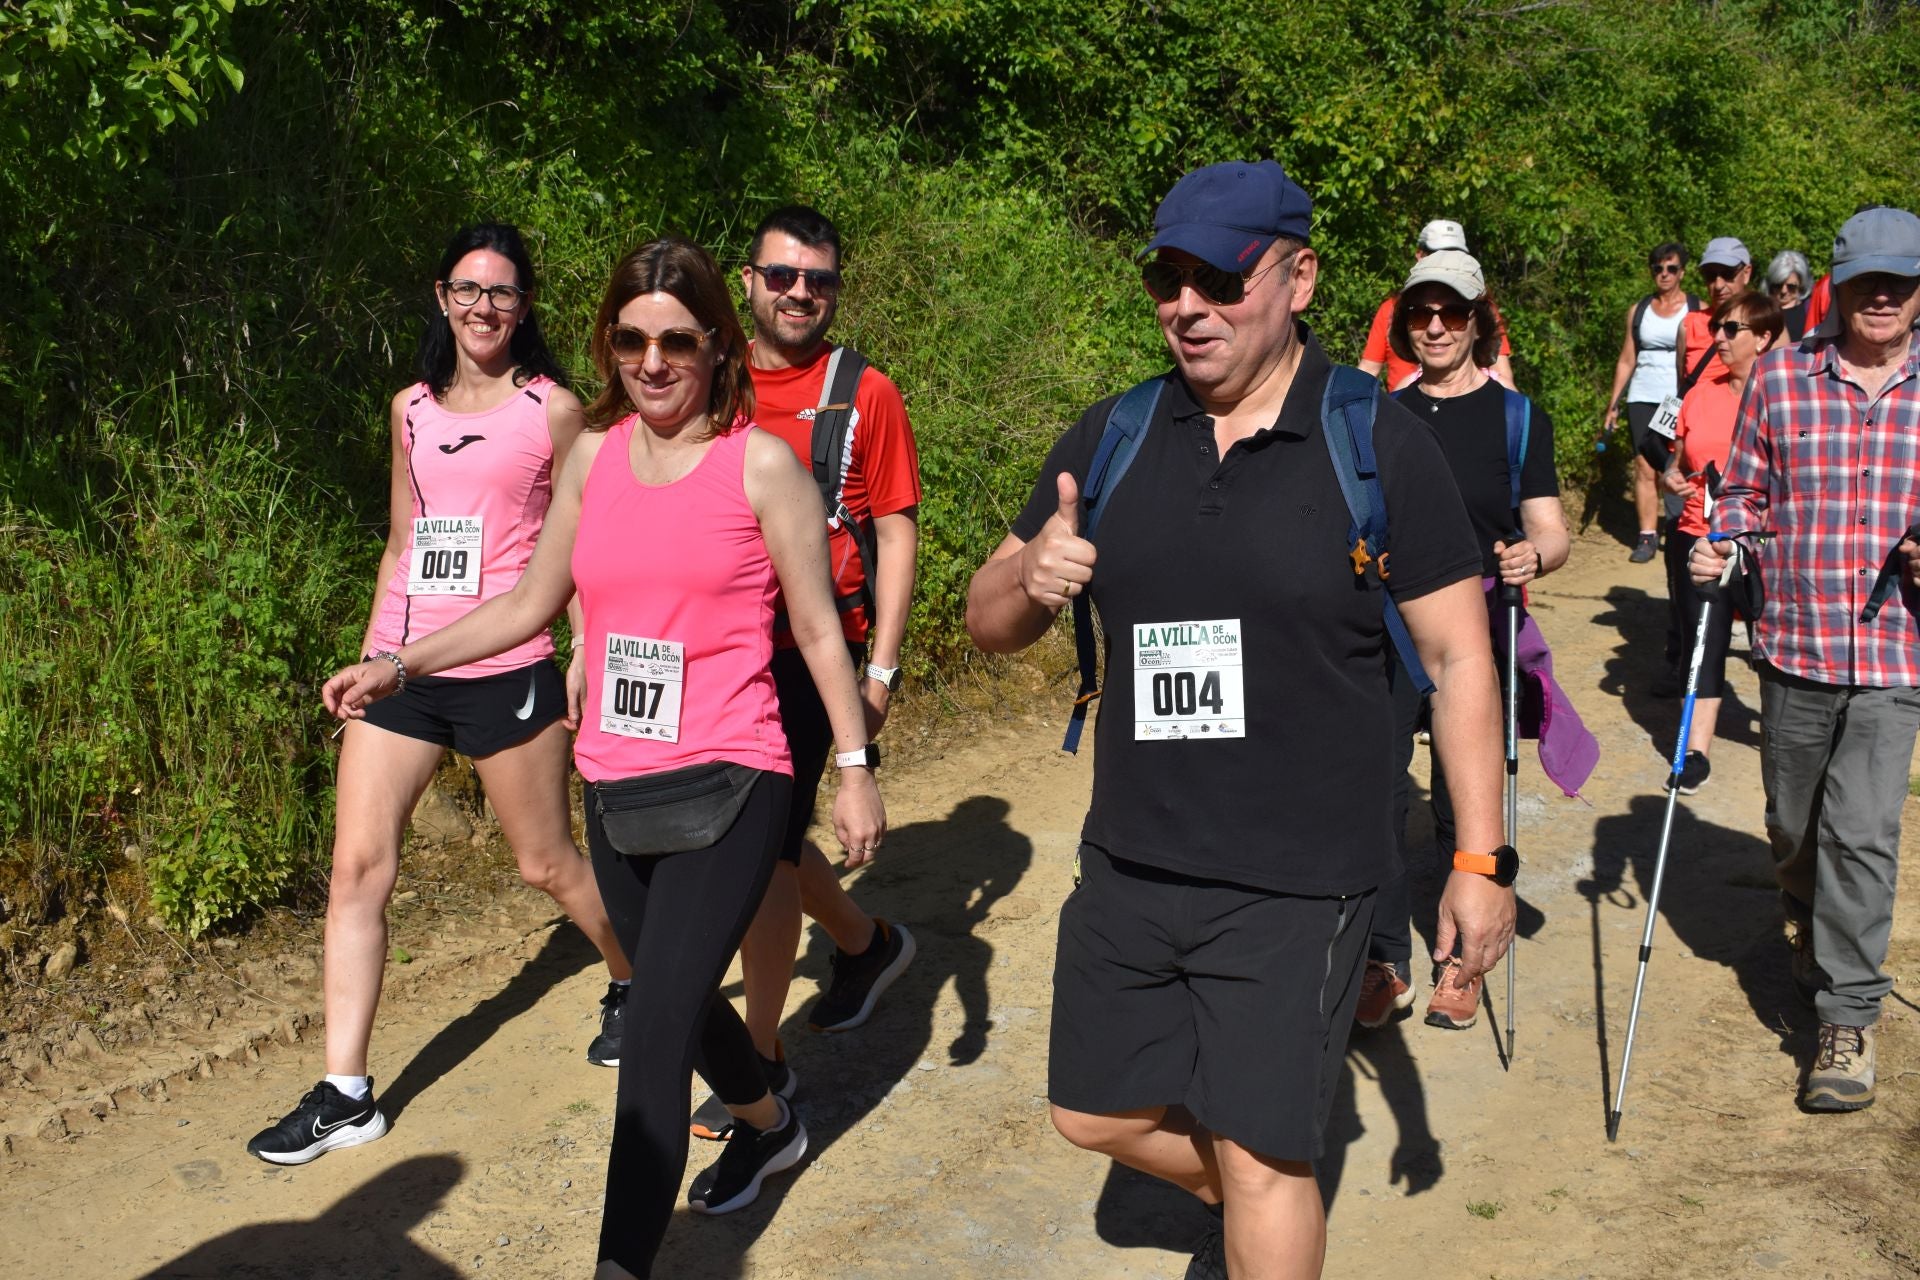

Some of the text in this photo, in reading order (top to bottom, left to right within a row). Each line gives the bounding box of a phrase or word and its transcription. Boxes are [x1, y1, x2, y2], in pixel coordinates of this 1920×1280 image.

[416, 520, 464, 534] LA VILLA
[422, 550, 468, 579] 009
[1138, 625, 1211, 648] LA VILLA
[1212, 625, 1224, 634] DE
[1212, 632, 1237, 645] OCÓN
[608, 637, 660, 660] LA VILLA
[662, 644, 671, 653] DE
[614, 677, 666, 720] 007
[1152, 670, 1224, 716] 004
